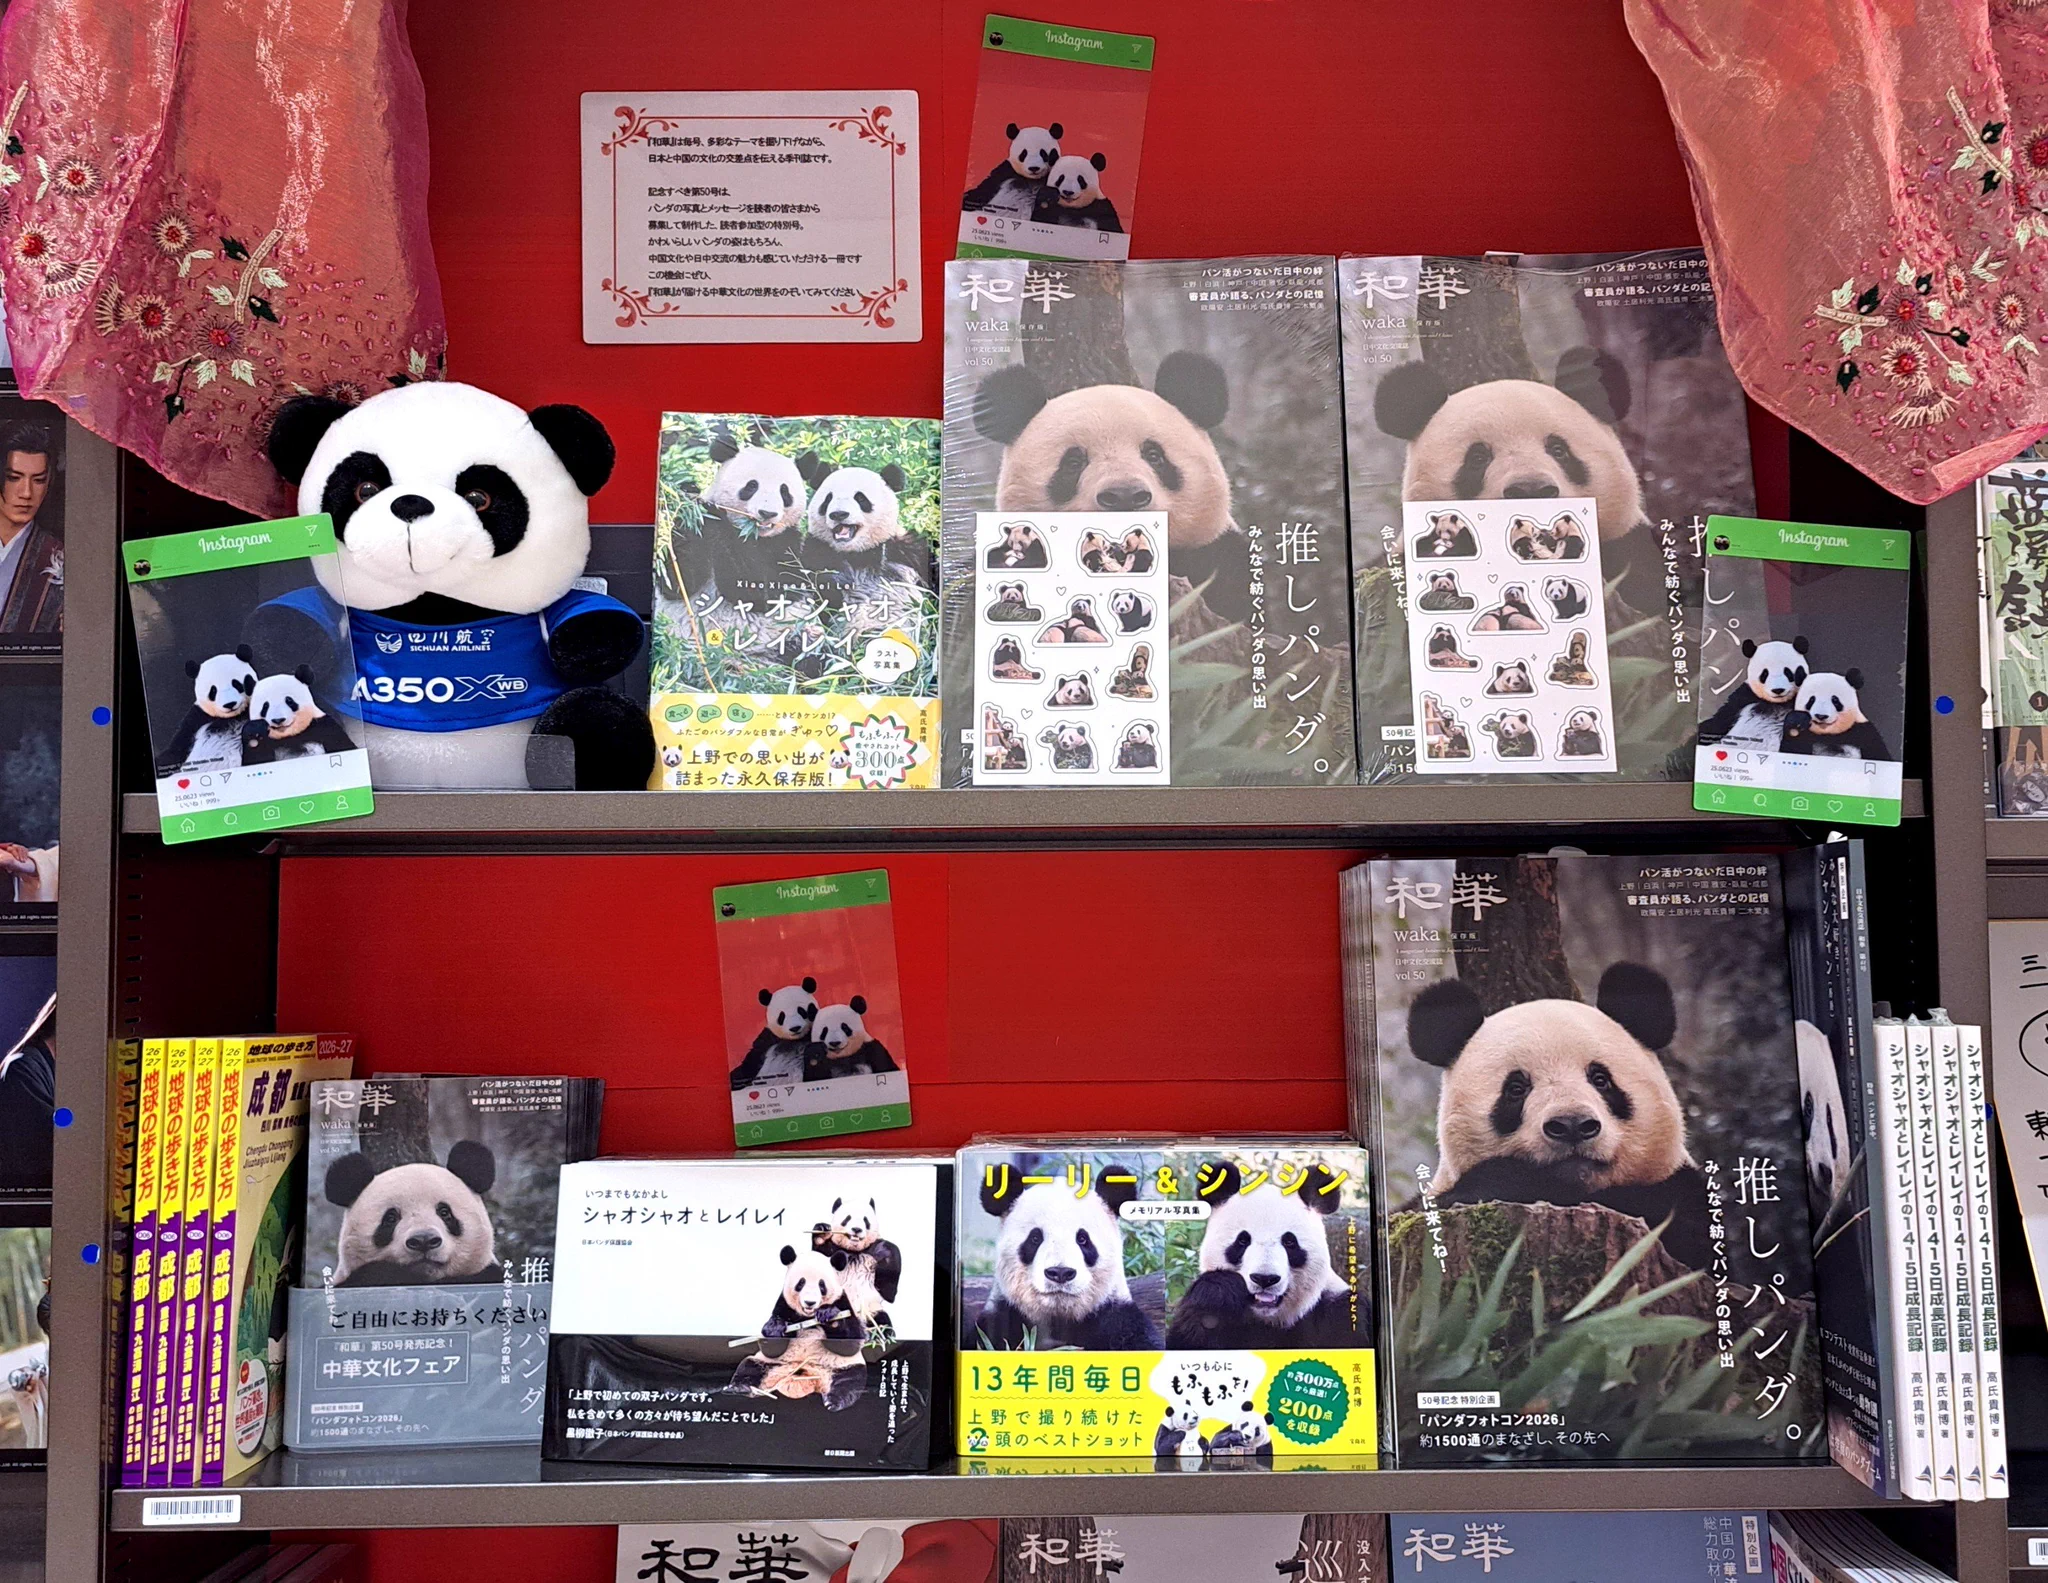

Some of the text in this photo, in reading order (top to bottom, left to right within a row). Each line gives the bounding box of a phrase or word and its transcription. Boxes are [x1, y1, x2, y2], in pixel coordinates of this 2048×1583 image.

[1045, 30, 1104, 51] Instagram
[648, 153, 832, 164] 日本と中国の文化の交差点を伝える季刊誌です。
[959, 270, 1076, 314] 和華
[1353, 266, 1472, 310] 和華
[965, 318, 1009, 332] waka
[1362, 315, 1406, 330] waka
[198, 531, 273, 554] Instagram
[1778, 528, 1850, 551] Instagram
[736, 580, 765, 589] Xiao
[695, 594, 895, 621] シャオシャオ
[1247, 524, 1268, 710] みんなで紡ぐパンダの思い出
[1659, 518, 1691, 703] みんなで紡ぐパンダの思い出
[408, 628, 495, 644] 四川航空
[410, 644, 491, 652] SICHUAN AIRLINES
[733, 628, 859, 655] レイレイ
[1274, 521, 1330, 774] 推しパンダ。
[873, 660, 901, 670] 写真集
[876, 649, 899, 658] ラスト
[687, 749, 825, 766] 上野での思い出が
[675, 770, 833, 788] 詰まった永久保存版！
[1639, 866, 1768, 878] パン活がつないだ日中の絆
[776, 883, 839, 901] Instagram
[1385, 872, 1508, 921] 和華
[1627, 893, 1770, 906] 審査員が語る、パンダとの記憶
[1393, 926, 1440, 942] waka
[247, 1040, 316, 1056] 地球の歩き方
[246, 1068, 293, 1118] 成都
[316, 1083, 397, 1116] 和華
[137, 1068, 160, 1203] 地球の歩き方
[189, 1068, 213, 1202] 地球の歩き方
[217, 1068, 241, 1203] 地球の歩き方
[321, 1118, 352, 1130] waka
[163, 1069, 186, 1204] 地球の歩き方
[984, 1162, 1350, 1200] リーリー & シンシン
[585, 1188, 669, 1200] いつまでもなかよし
[582, 1206, 787, 1227] シャオシャオとレイレイ
[1129, 1204, 1201, 1216] メモリアル写真集
[1414, 1162, 1449, 1274] 会いに来てね！
[1889, 1044, 1923, 1353] シャオシャオとレイレイの1415日成長記録
[1911, 1371, 1926, 1426] 高氏貴博
[1914, 1044, 1948, 1353] シャオシャオとレイレイの1415日成長記録
[1935, 1371, 1950, 1426] 高氏貴博
[1942, 1044, 1974, 1353] シャオシャオとレイレイの1415日成長記録
[1961, 1372, 1976, 1426] 高氏貴博
[1966, 1043, 1999, 1352] シャオシャオとレイレイの1415日成長記録
[1986, 1371, 2001, 1425] 高氏貴博
[1704, 1159, 1736, 1369] みんなで紡ぐパンダの思い出
[1732, 1154, 1802, 1441] 推しパンダ。
[331, 1306, 548, 1330] ご自由にお持ちください
[370, 1337, 455, 1352] 第50号発売記念！
[322, 1354, 462, 1381] 中華文化フェア
[1180, 1361, 1233, 1372] いつも心に
[970, 1364, 1141, 1394] 13年間毎日
[1352, 1363, 1362, 1408] 高氏貴博
[567, 1388, 714, 1403] 「上野で初めての双子パンダです。
[567, 1408, 777, 1425] 私を含めて多くの方々が待ち望んだことでした」
[967, 1409, 1143, 1427] 上野で撮り続けた
[1278, 1397, 1334, 1421] 200点
[1418, 1412, 1567, 1428] 「パンダフォトコン2026」
[1286, 1419, 1321, 1436] を収録
[1419, 1430, 1611, 1448] 約1500通のまなざし、その先へ
[967, 1427, 1144, 1453] 2頭のベストショット
[1019, 1528, 1126, 1575] 和華
[1404, 1522, 1515, 1575] 和華
[1745, 1520, 1760, 1568] 特別企画
[638, 1532, 810, 1583] 和華
